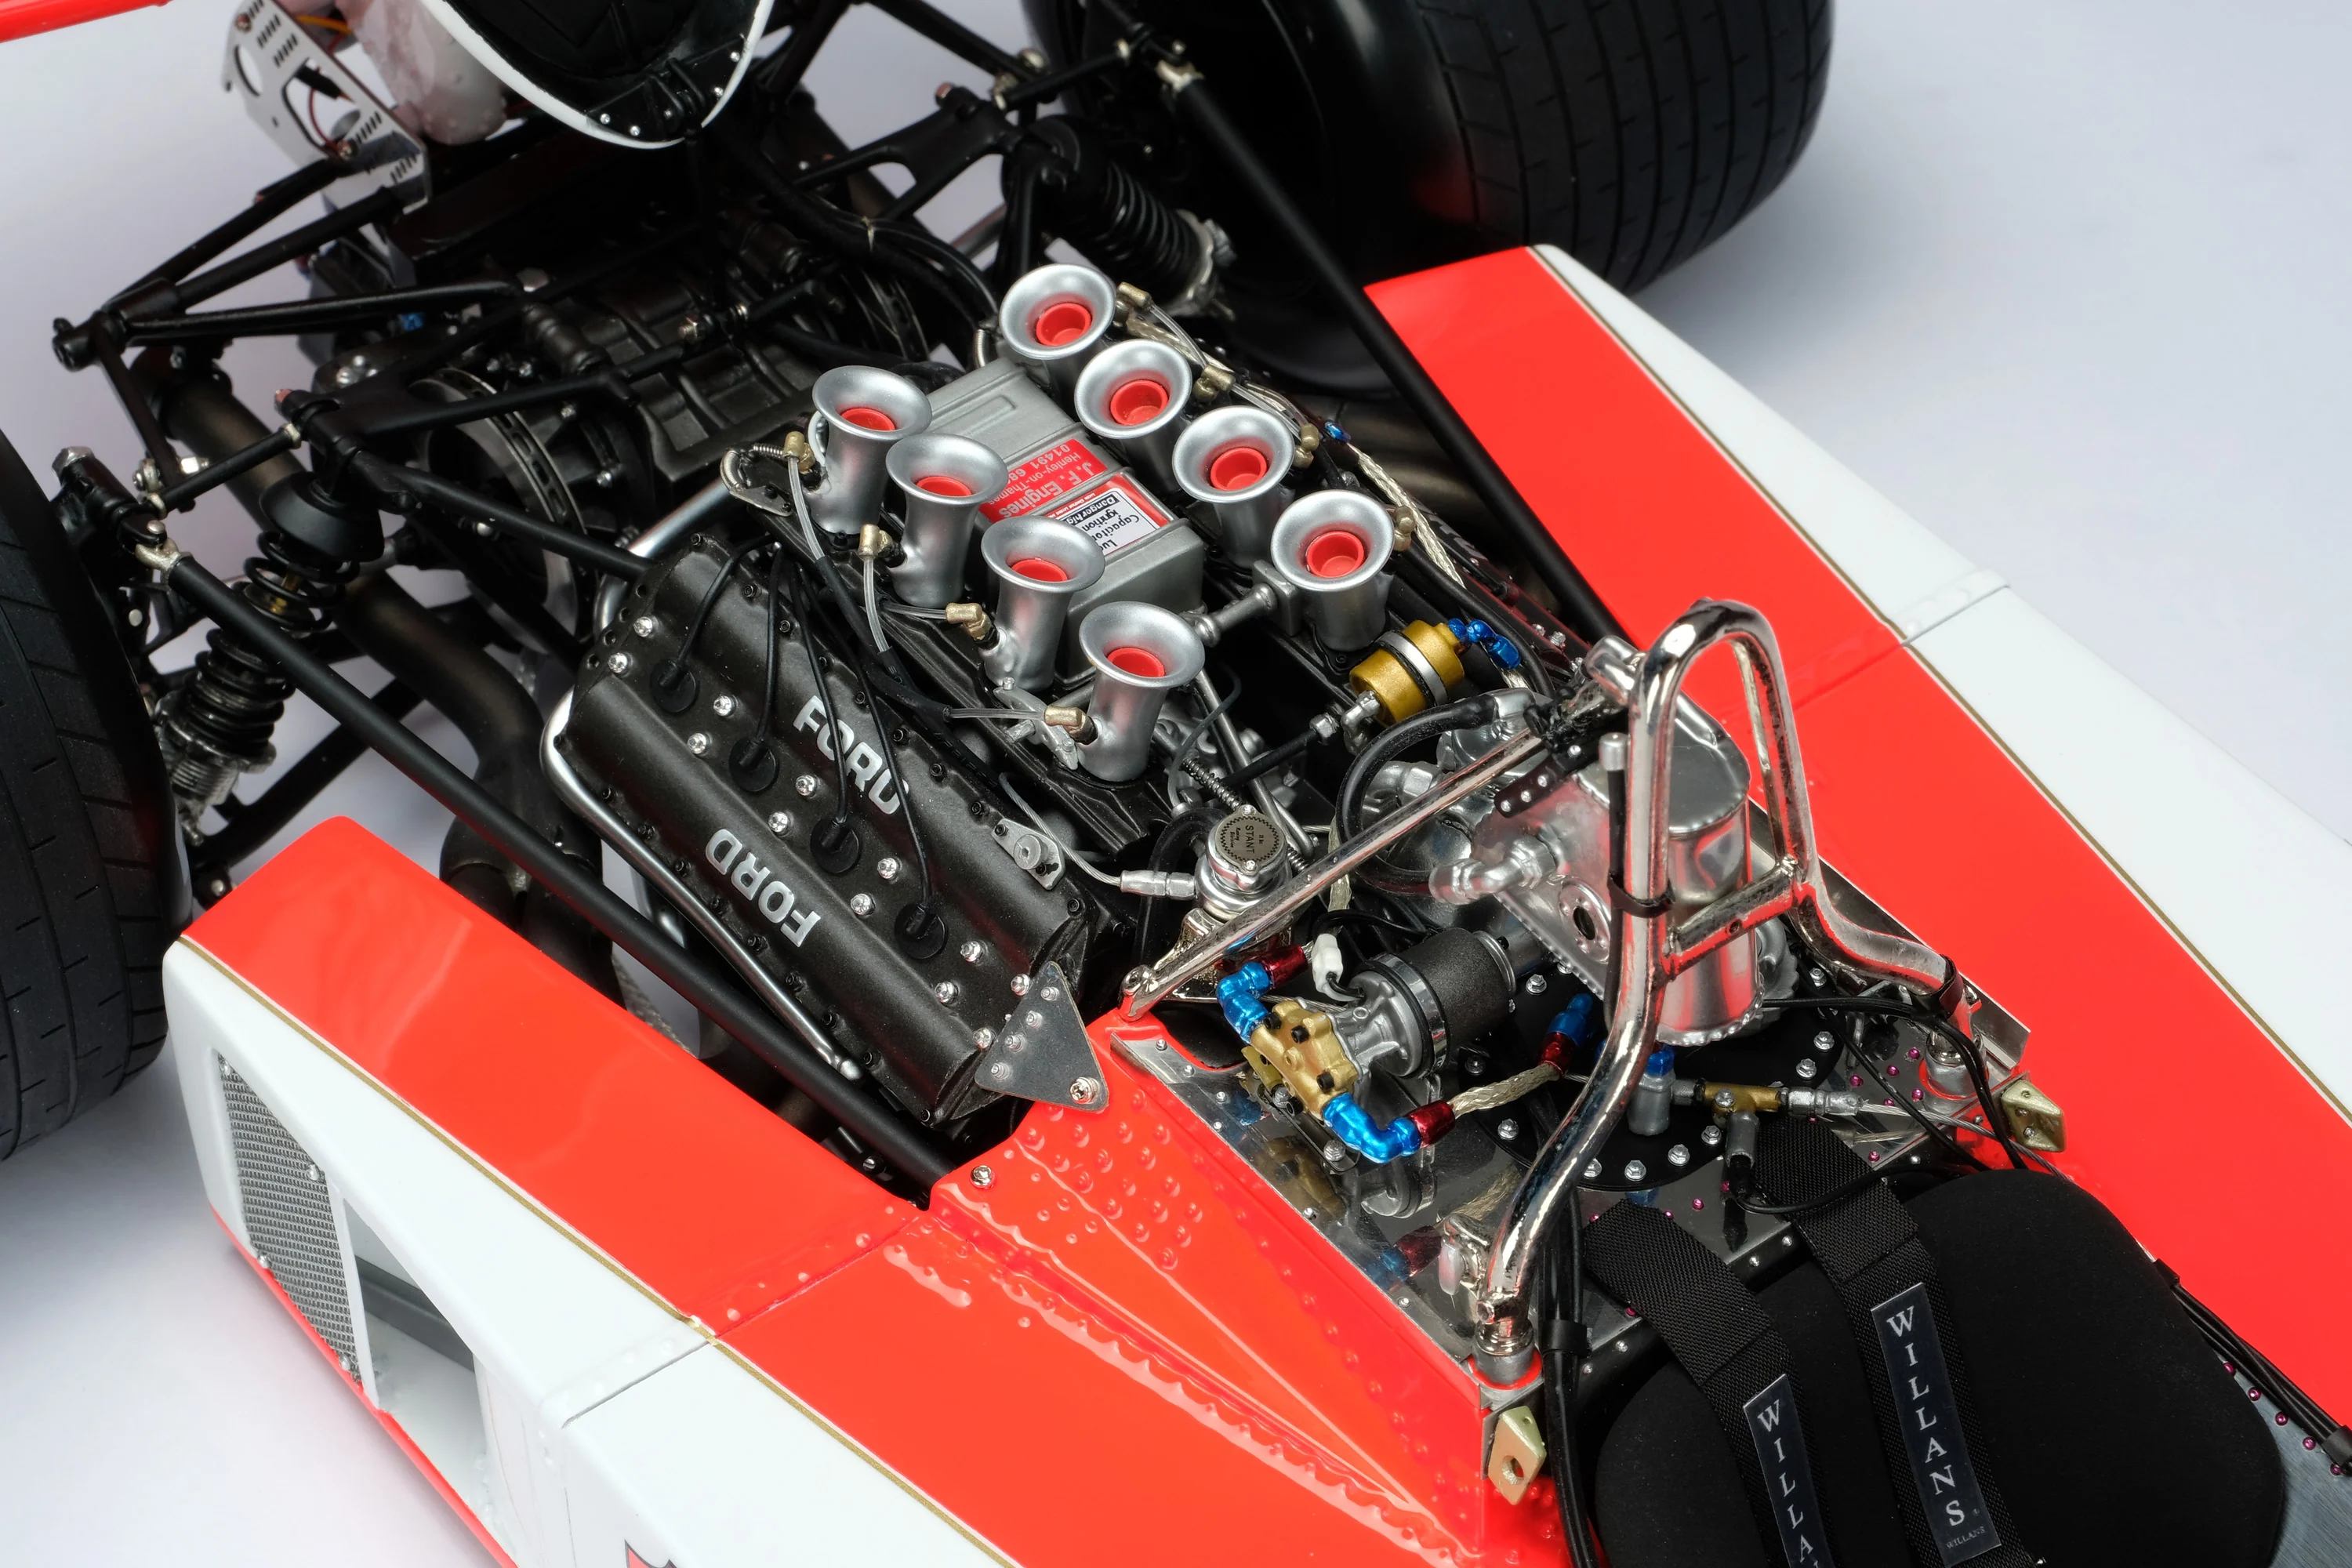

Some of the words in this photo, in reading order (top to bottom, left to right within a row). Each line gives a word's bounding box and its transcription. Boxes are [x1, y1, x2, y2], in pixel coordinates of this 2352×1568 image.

[1029, 444, 1070, 470] 01491
[1077, 461, 1094, 476] J.
[1059, 474, 1082, 486] F.
[998, 480, 1065, 518] Engines
[1083, 496, 1116, 517] Danger
[1082, 508, 1121, 532] ignition
[1091, 514, 1140, 541] Capacitor
[793, 695, 909, 815] FORD
[1245, 825, 1255, 854] STANT
[705, 828, 822, 948] FORD
[1886, 1305, 1965, 1526] WILLANS
[1945, 1526, 1986, 1550] WILLANS
